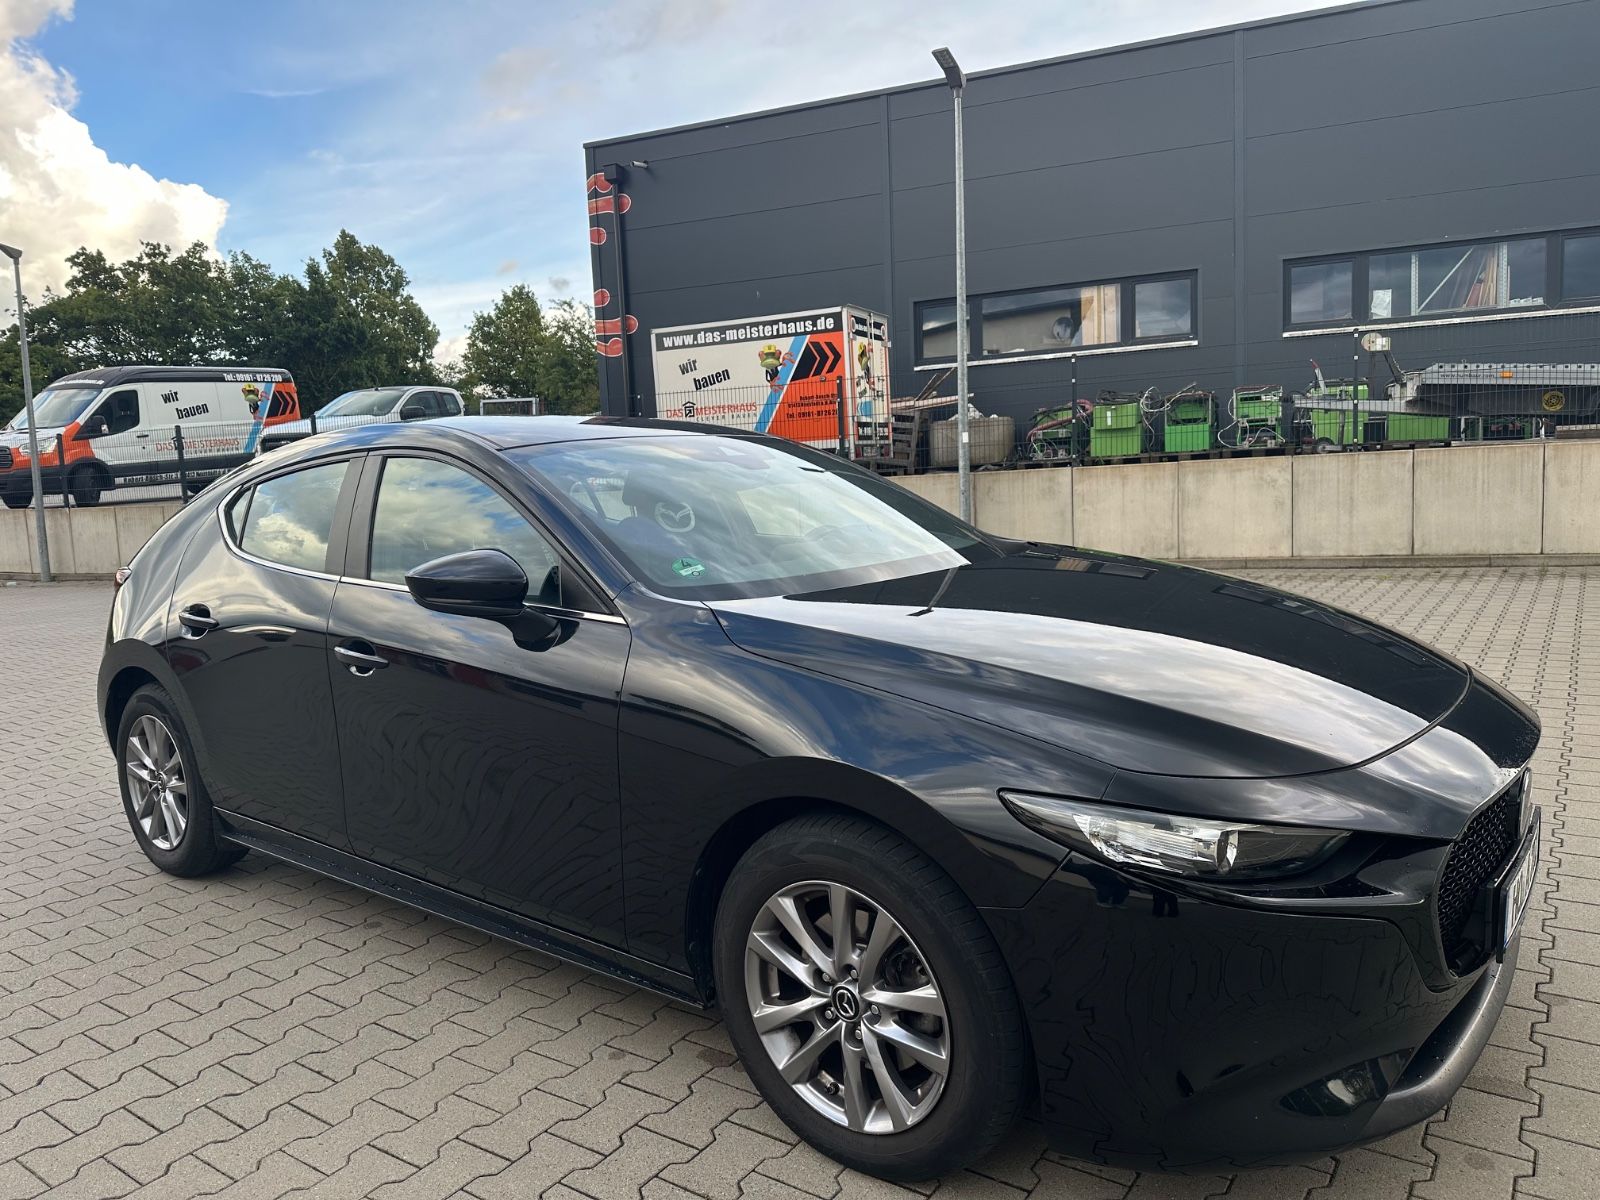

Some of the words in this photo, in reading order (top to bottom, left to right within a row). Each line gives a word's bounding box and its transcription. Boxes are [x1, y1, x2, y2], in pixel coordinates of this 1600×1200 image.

[663, 316, 835, 348] www.das-meisterhaus.de
[678, 358, 698, 376] wir
[693, 367, 731, 391] bauen
[160, 390, 179, 404] wir
[175, 403, 209, 420] bauen
[666, 408, 683, 418] DAS
[695, 402, 758, 416] MEISTERHAUS
[155, 441, 173, 452] DAS
[184, 438, 240, 450] MEISTERHAUS
